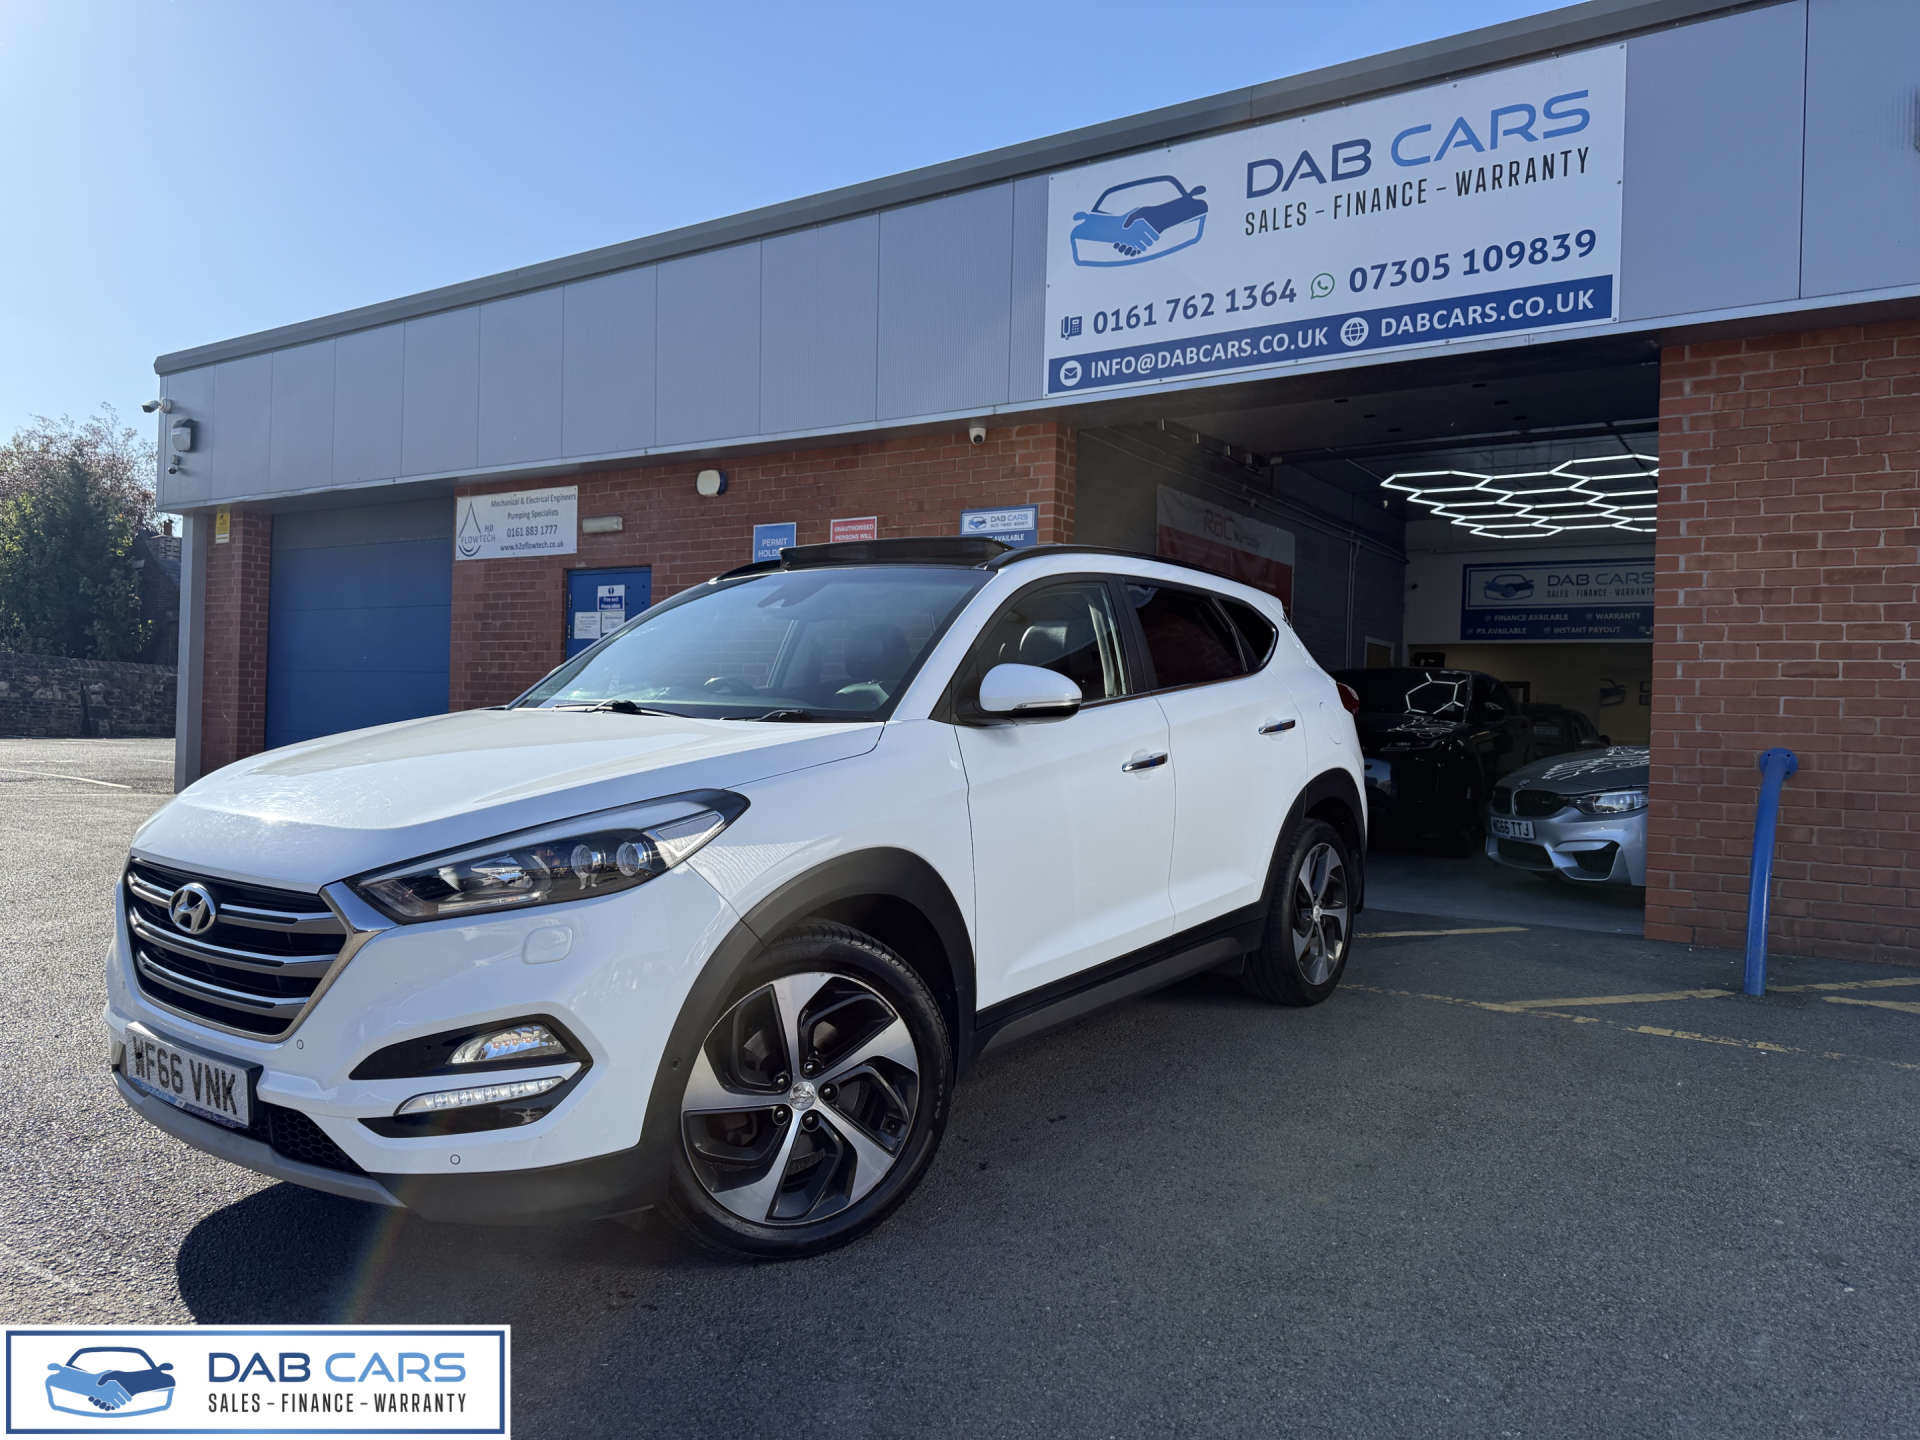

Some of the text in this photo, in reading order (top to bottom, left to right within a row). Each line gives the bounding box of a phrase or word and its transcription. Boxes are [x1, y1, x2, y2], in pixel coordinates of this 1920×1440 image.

[1246, 89, 1590, 199] DAB CARS
[1245, 202, 1307, 236] SALES
[1333, 178, 1428, 220] FINANCE
[1455, 147, 1589, 197] WARRANTY
[1349, 229, 1596, 293] 07305 109839
[1093, 278, 1297, 335] 0161 762 1364
[1381, 288, 1594, 337] DABCARS.CO.UK
[1091, 327, 1328, 379] INFO@DABCARS.CO.UK
[506, 524, 558, 538] 0161 883 1777
[507, 511, 531, 520] Pumping
[762, 537, 787, 547] PERMIT
[1547, 571, 1654, 586] DAB CARS
[132, 1036, 184, 1094] WF66
[189, 1058, 237, 1115] VNK
